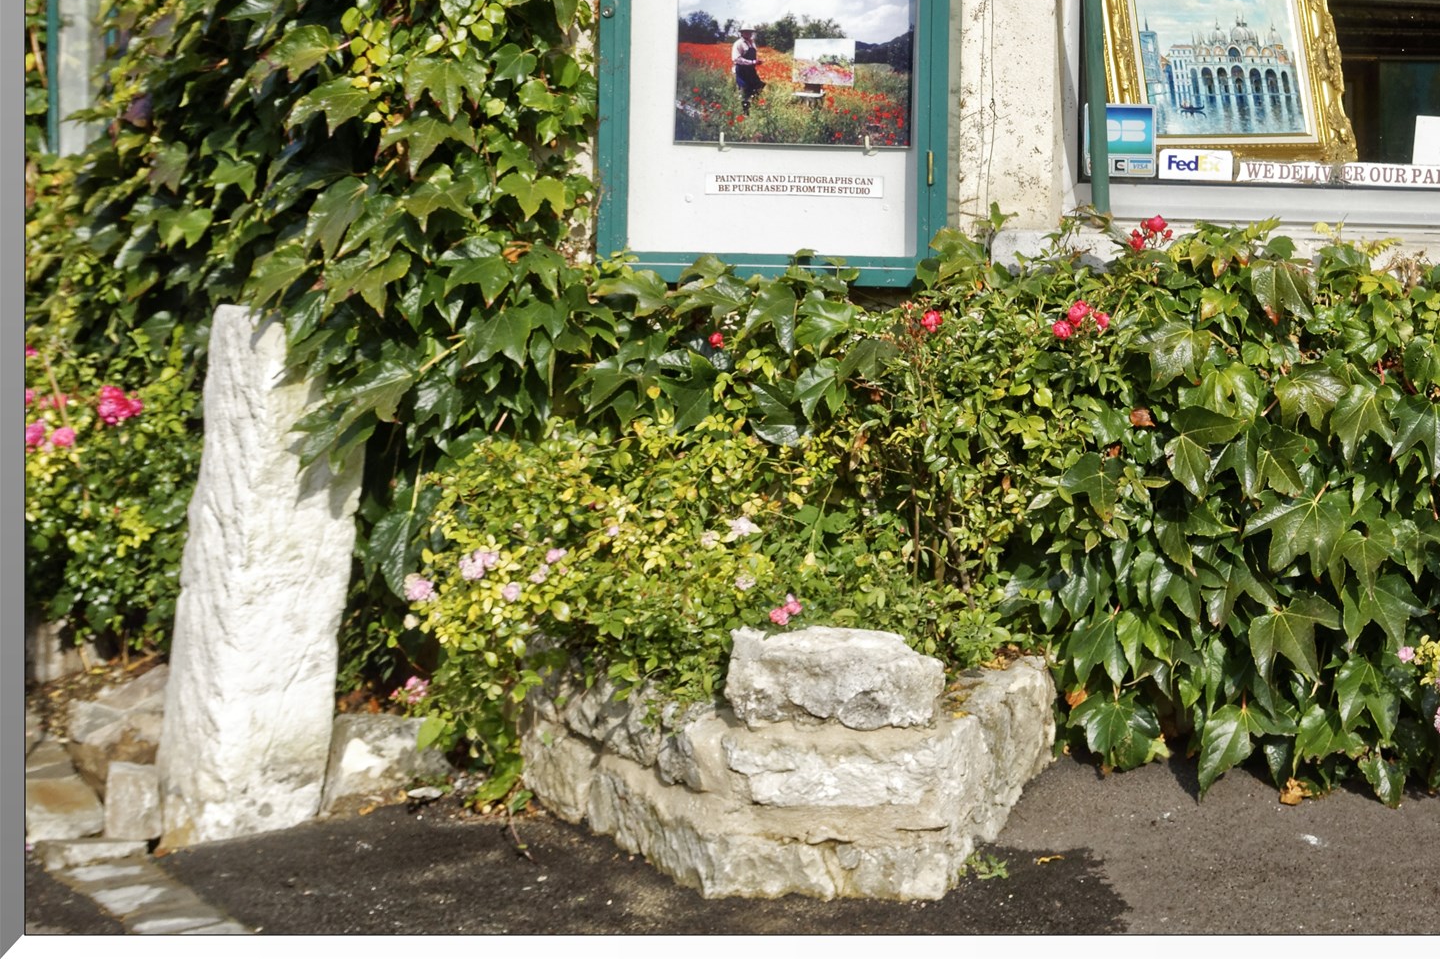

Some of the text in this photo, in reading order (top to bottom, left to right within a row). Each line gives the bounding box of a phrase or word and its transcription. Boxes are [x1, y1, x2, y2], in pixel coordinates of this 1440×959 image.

[1168, 155, 1220, 171] FedEx
[1246, 163, 1275, 179] WE
[1370, 167, 1407, 183] OUR
[715, 175, 874, 186] PAINTINGS AND LITHOGRAPHS CAN
[718, 184, 871, 195] BE PURCHASED FROM THE STUDIO
